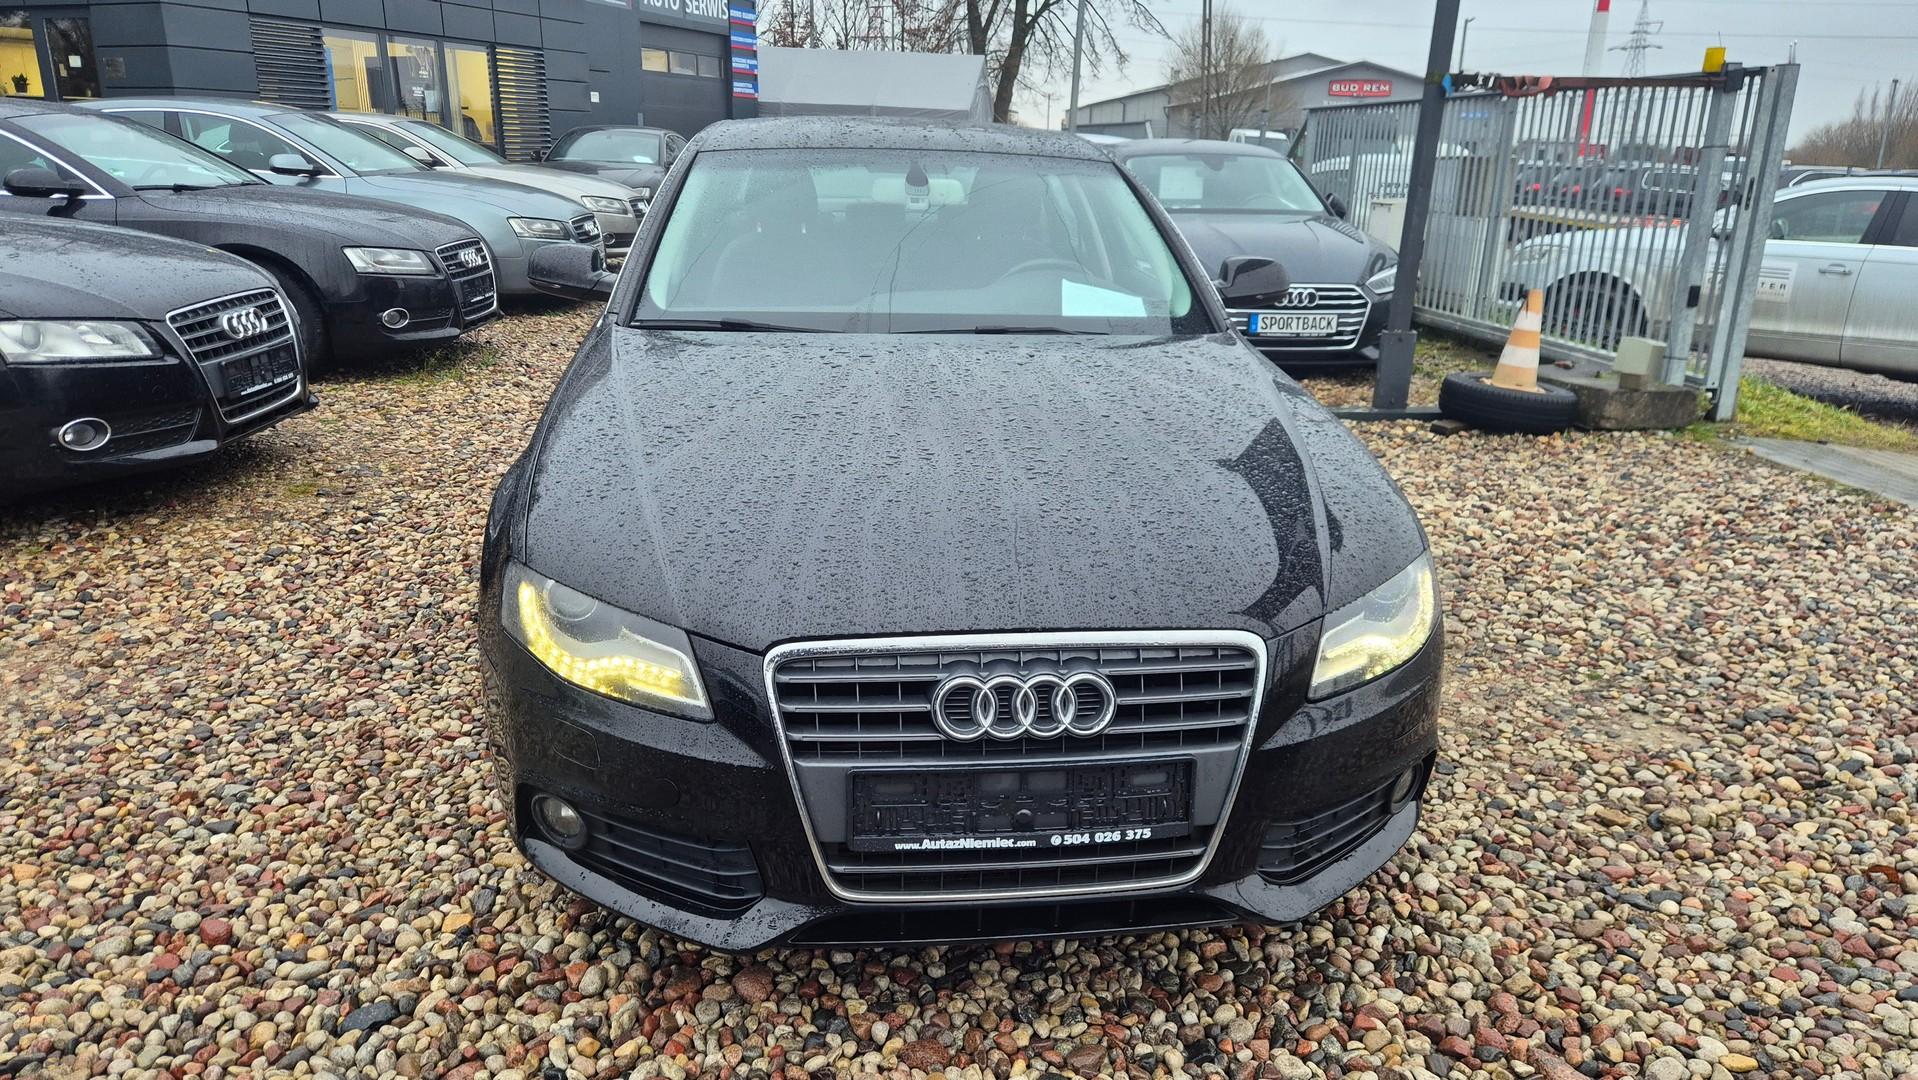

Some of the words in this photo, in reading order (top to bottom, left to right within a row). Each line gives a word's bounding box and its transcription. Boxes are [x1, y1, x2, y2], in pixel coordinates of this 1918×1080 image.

[685, 0, 730, 20] SERWIS
[1332, 83, 1359, 92] BUD
[1363, 83, 1390, 93] REM
[1261, 316, 1335, 331] SPORTBACK
[1063, 833, 1091, 845] 504
[1094, 831, 1121, 843] 026
[1125, 828, 1152, 841] 375
